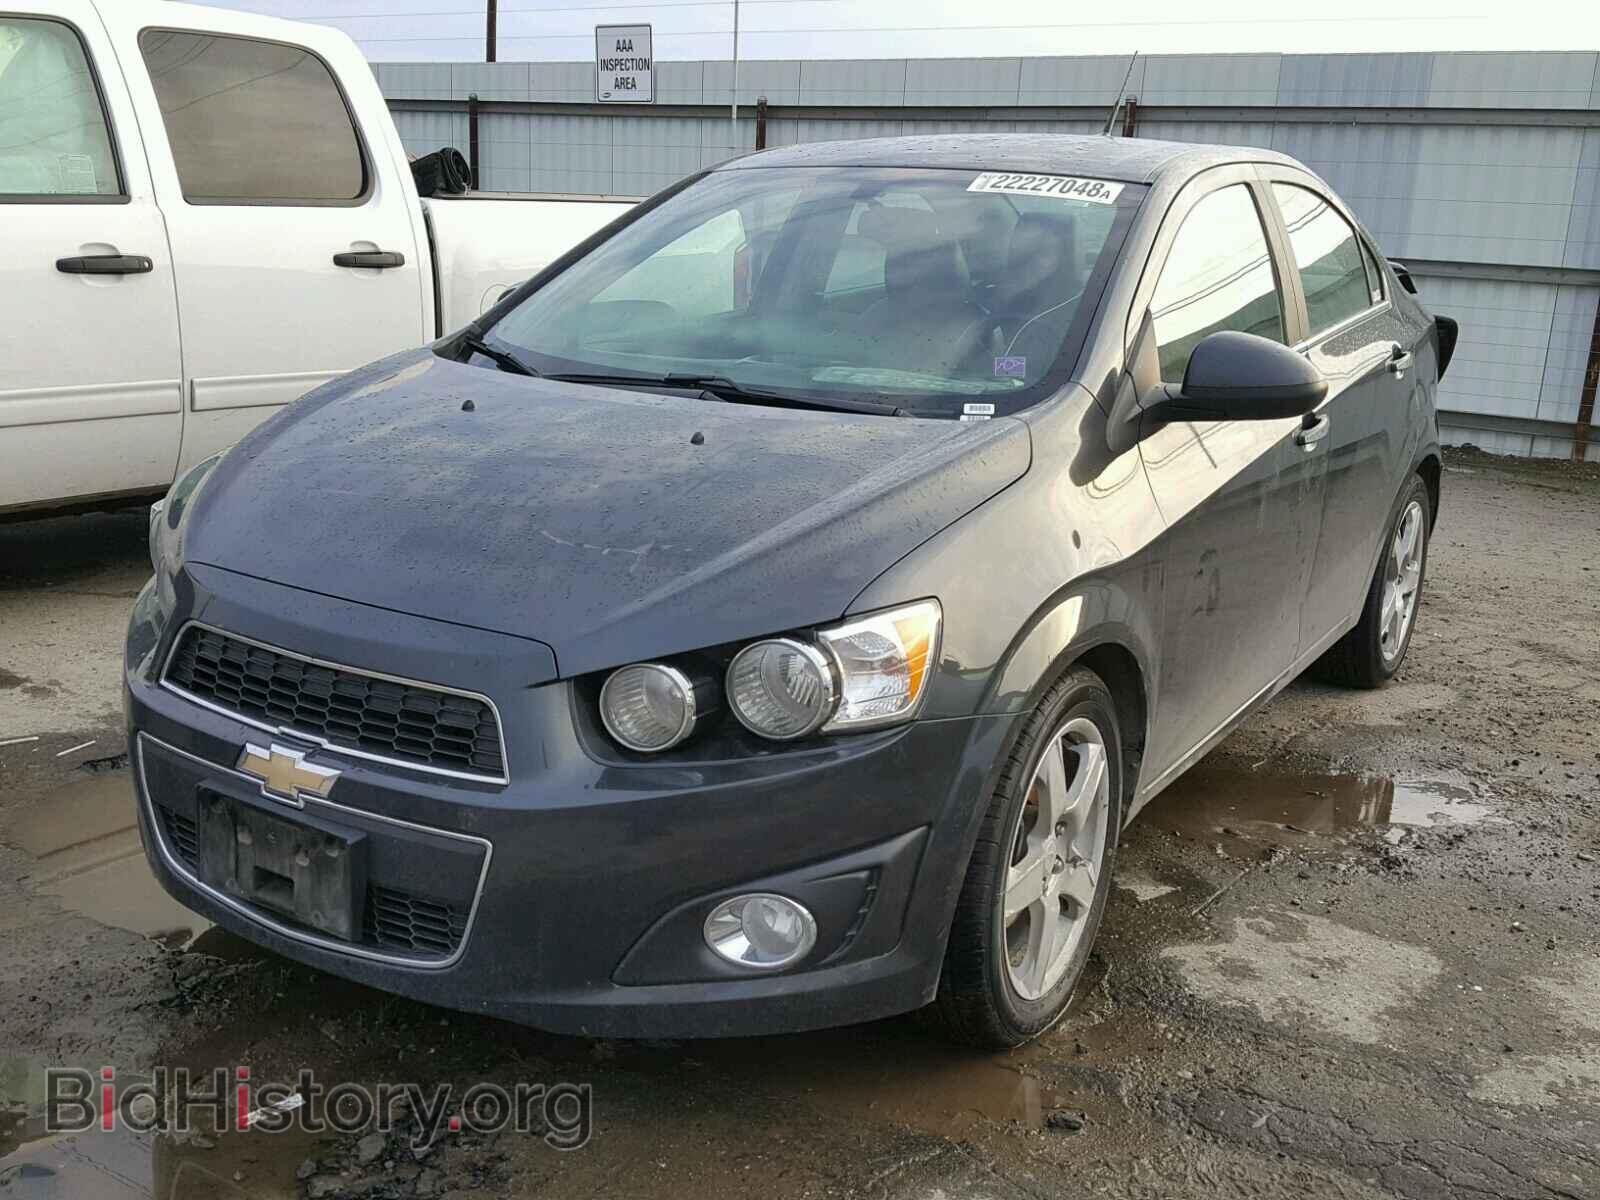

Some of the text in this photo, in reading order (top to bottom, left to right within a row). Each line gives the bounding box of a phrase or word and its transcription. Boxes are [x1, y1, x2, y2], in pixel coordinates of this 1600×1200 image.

[616, 39, 633, 52] AAA
[600, 57, 650, 71] INSPECTION
[614, 76, 637, 89] AREA
